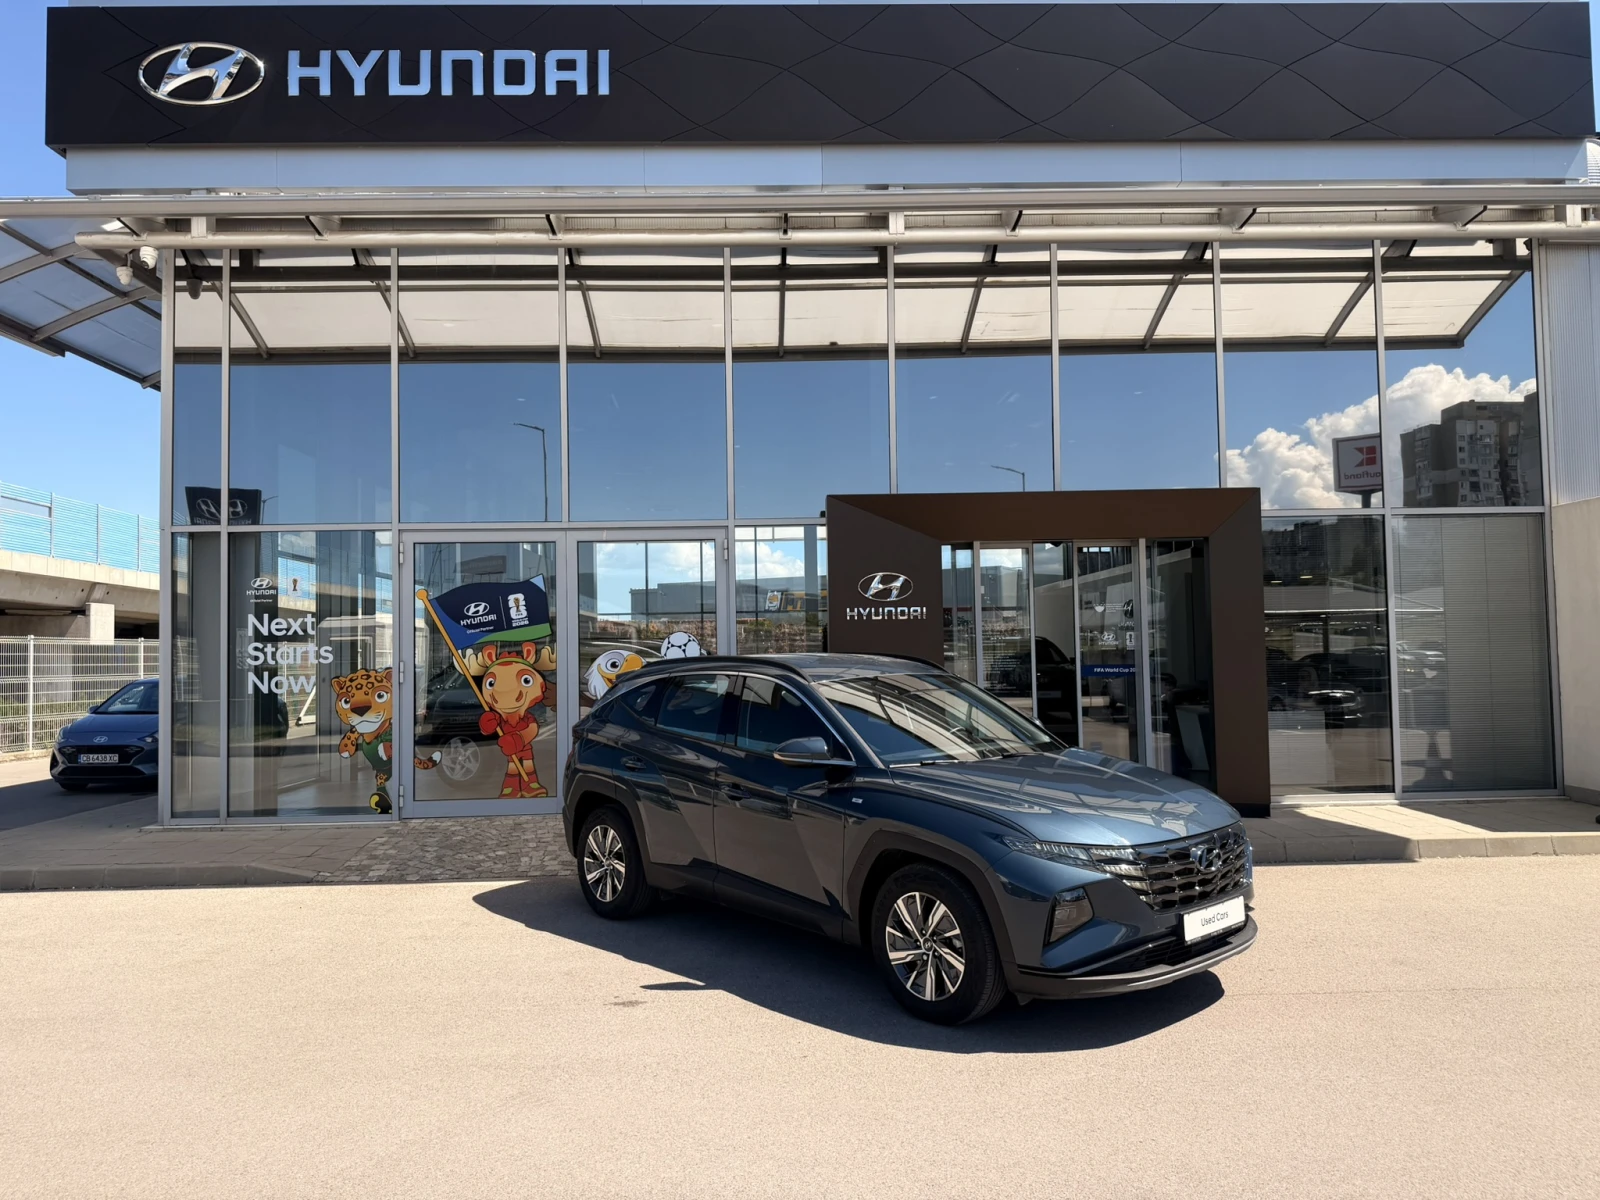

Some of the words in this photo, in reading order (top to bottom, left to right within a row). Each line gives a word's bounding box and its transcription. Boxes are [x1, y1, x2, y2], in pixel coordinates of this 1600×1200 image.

[287, 49, 610, 96] HYUNDAI
[247, 613, 316, 636] Next
[460, 614, 496, 626] HYUNDAI
[846, 606, 927, 620] HYUNDAI
[246, 642, 334, 666] Starts
[247, 671, 317, 695] Now
[1201, 915, 1215, 926] Used
[1216, 912, 1228, 921] Cars
